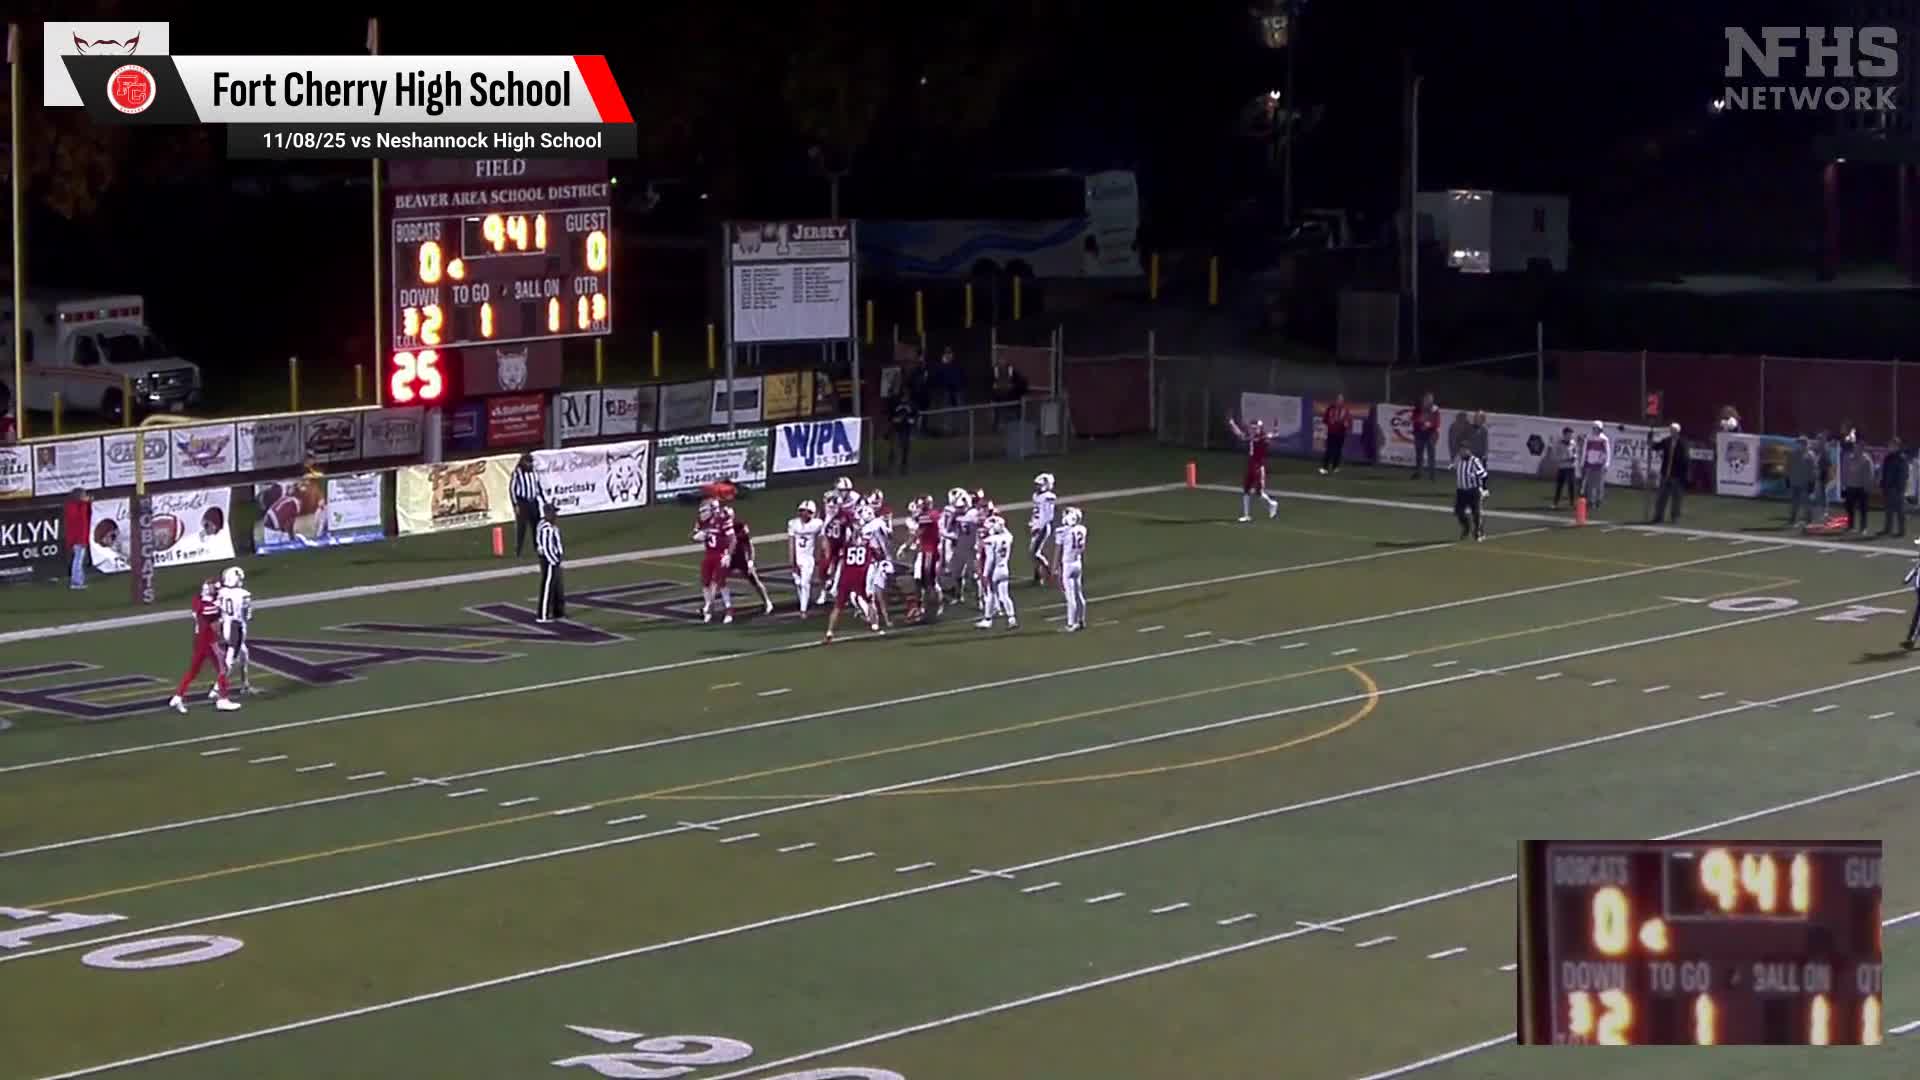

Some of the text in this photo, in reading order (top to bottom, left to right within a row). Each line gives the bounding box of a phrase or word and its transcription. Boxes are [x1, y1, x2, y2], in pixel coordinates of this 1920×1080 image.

[475, 159, 526, 178] FIELD
[395, 184, 608, 208] BEAVER AREA SCHOOL DISTRICT
[396, 222, 441, 242] BOBCATS
[565, 213, 606, 232] GUEST
[586, 230, 607, 272] 0
[418, 241, 441, 284] 0
[453, 284, 489, 303] TO GO
[544, 278, 560, 297] ON
[574, 277, 598, 295] QTR
[400, 287, 440, 308] DOWN
[480, 302, 493, 338] 1
[548, 297, 560, 333] 1
[390, 350, 443, 403] 25
[784, 421, 853, 466] WJPA
[0, 519, 60, 546] KLYN
[847, 547, 866, 565] 58
